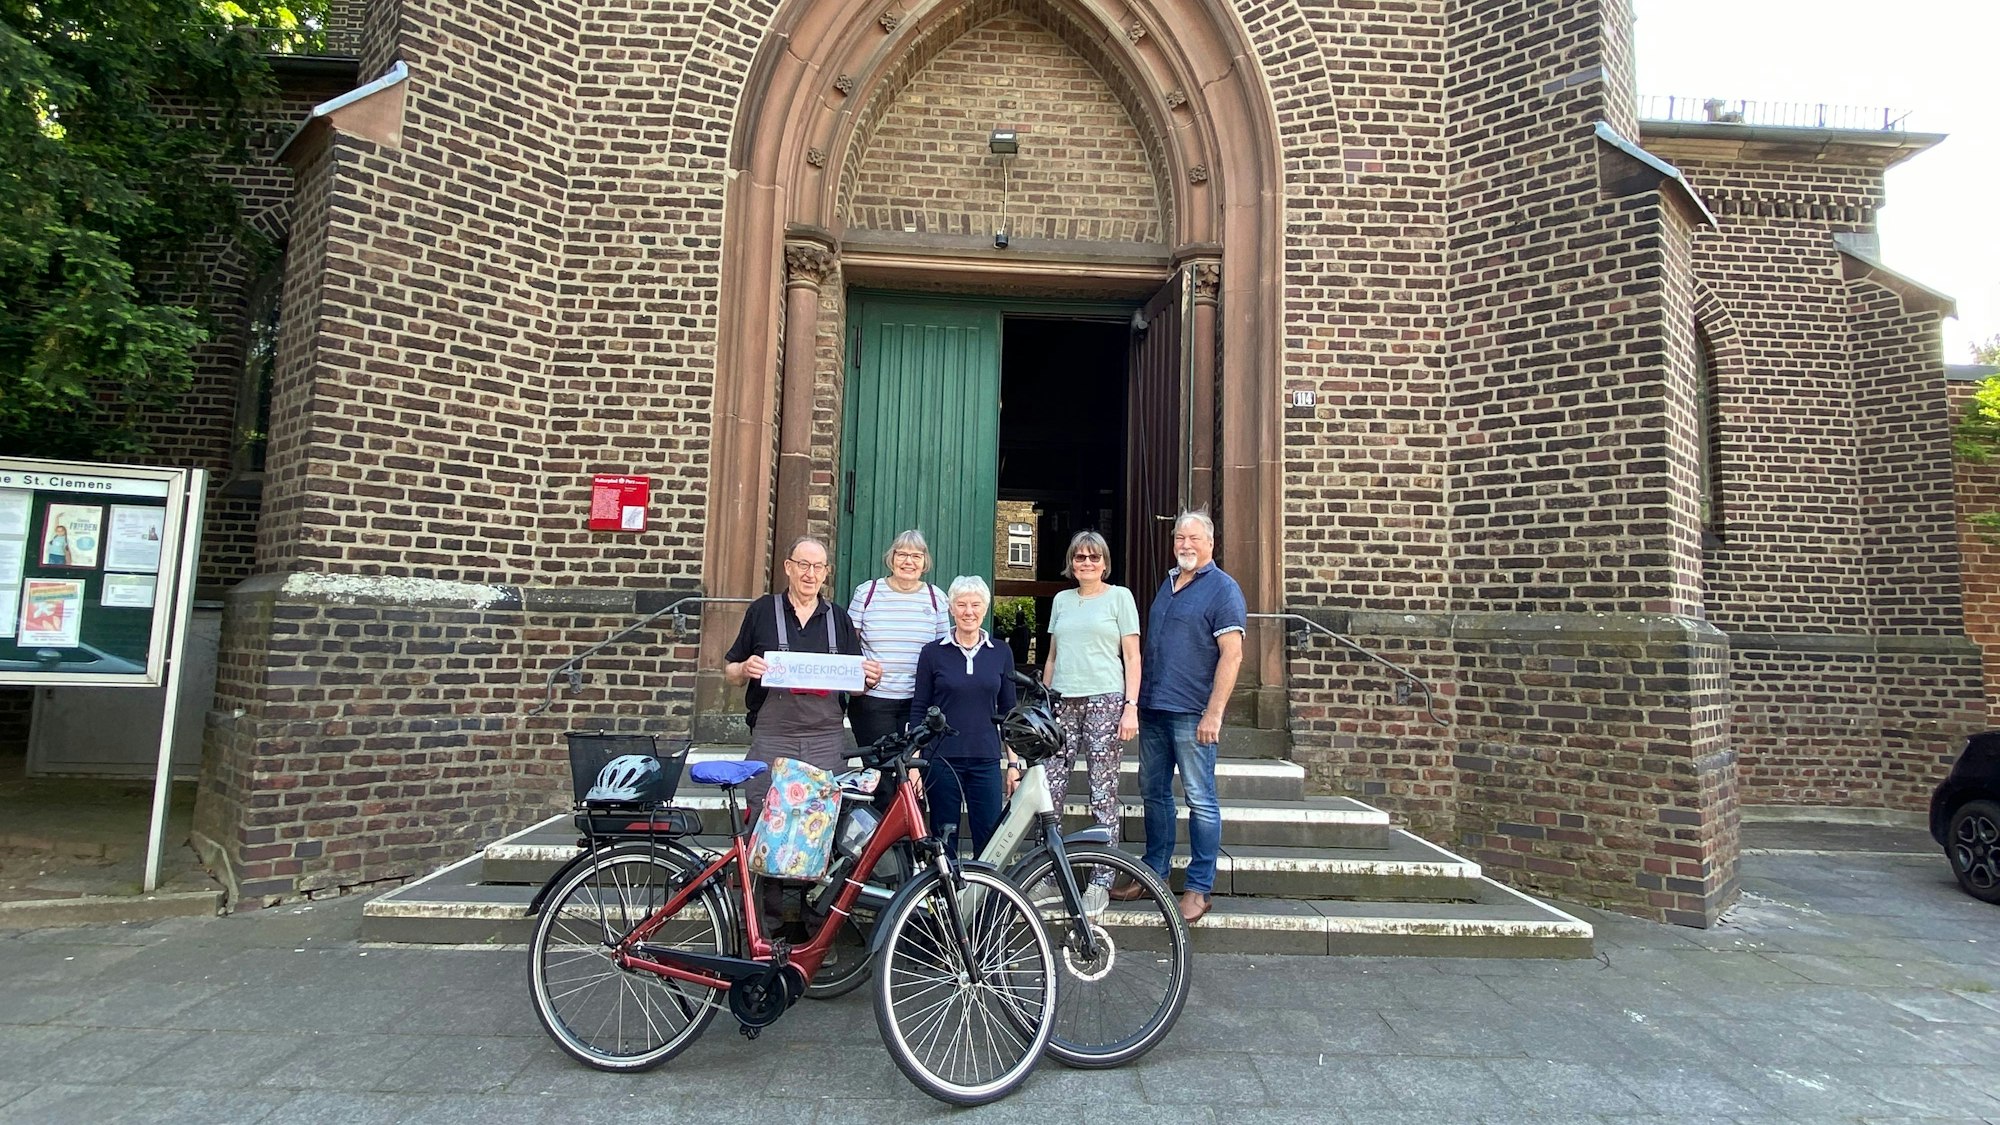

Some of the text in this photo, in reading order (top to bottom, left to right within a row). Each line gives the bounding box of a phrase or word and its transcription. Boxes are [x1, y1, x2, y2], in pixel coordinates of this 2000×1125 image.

[1296, 392, 1313, 405] 114
[23, 475, 44, 486] St.
[50, 477, 112, 490] Clemens
[788, 664, 860, 677] WEGEKIRCHE
